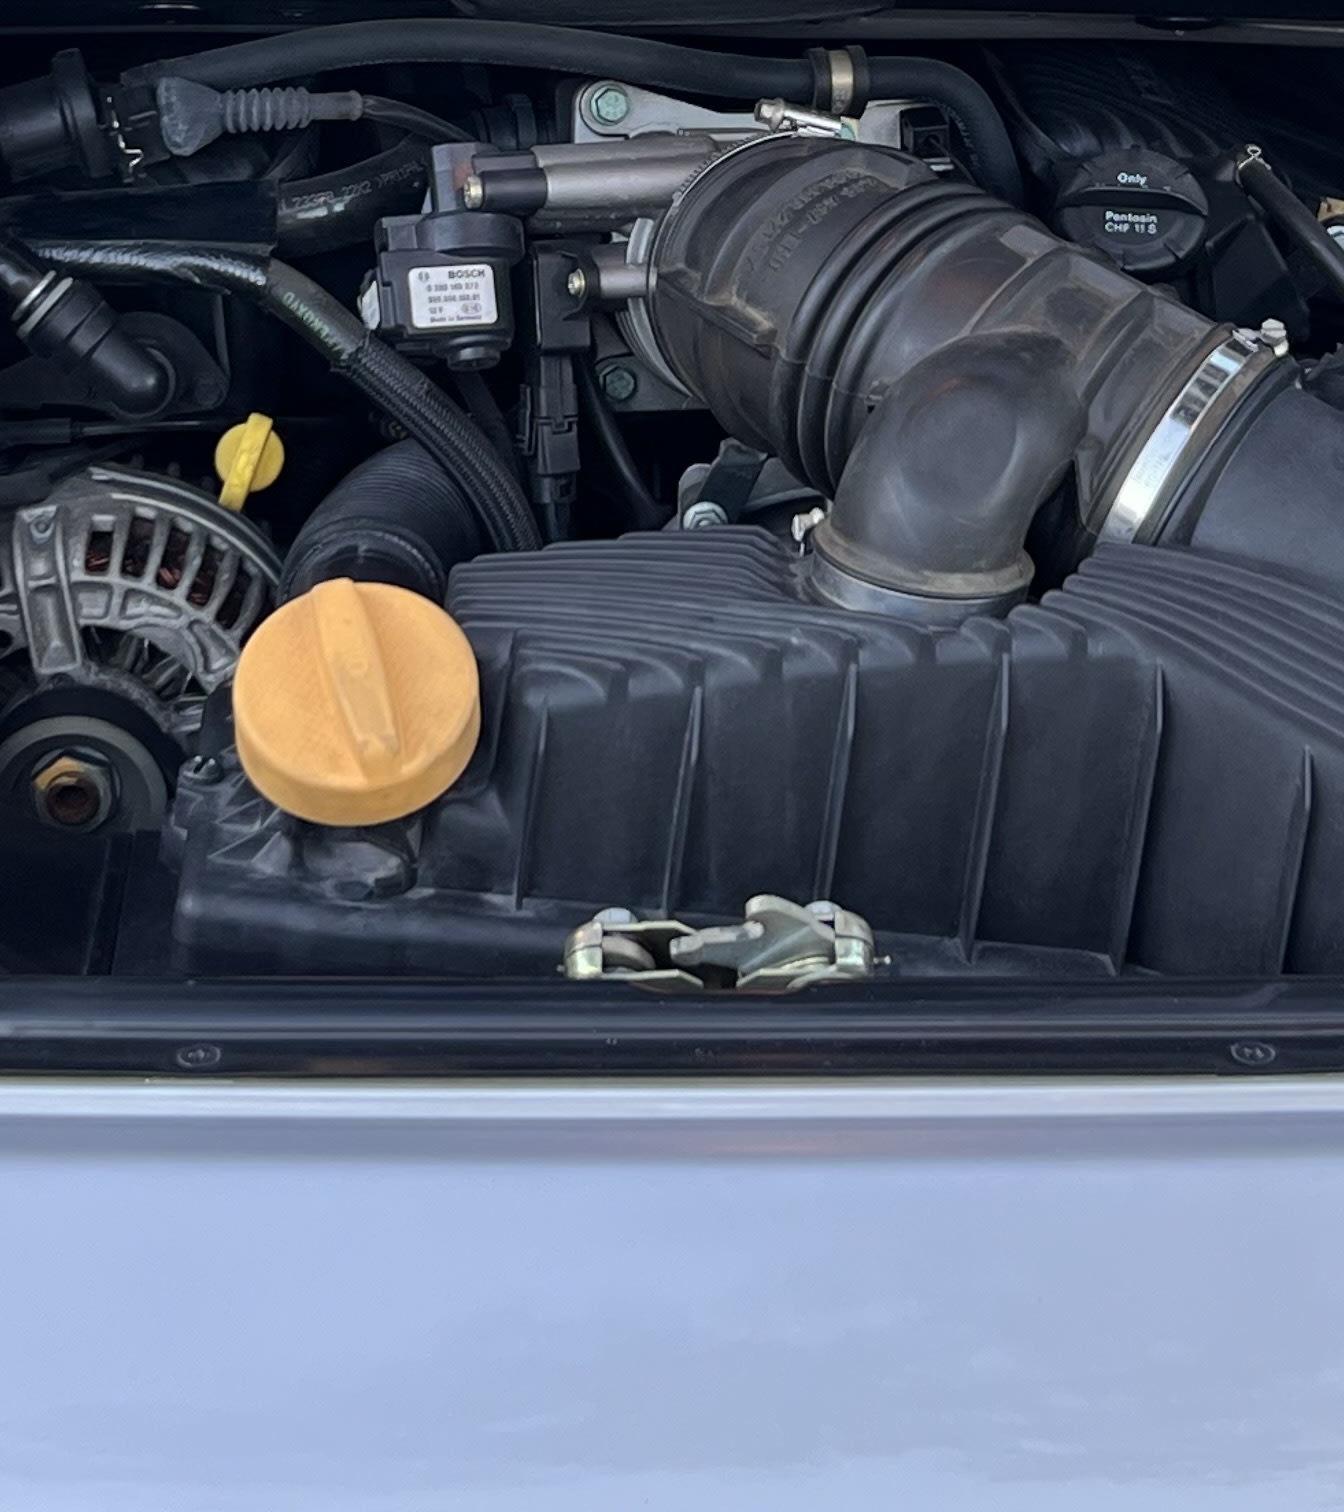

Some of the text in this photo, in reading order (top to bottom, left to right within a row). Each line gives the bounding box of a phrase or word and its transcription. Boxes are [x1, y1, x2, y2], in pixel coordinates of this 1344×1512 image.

[1117, 172, 1148, 186] Only
[1105, 210, 1158, 223] Pentosin
[1104, 222, 1158, 234] CHF 11 S
[448, 269, 486, 279] BOSCH
